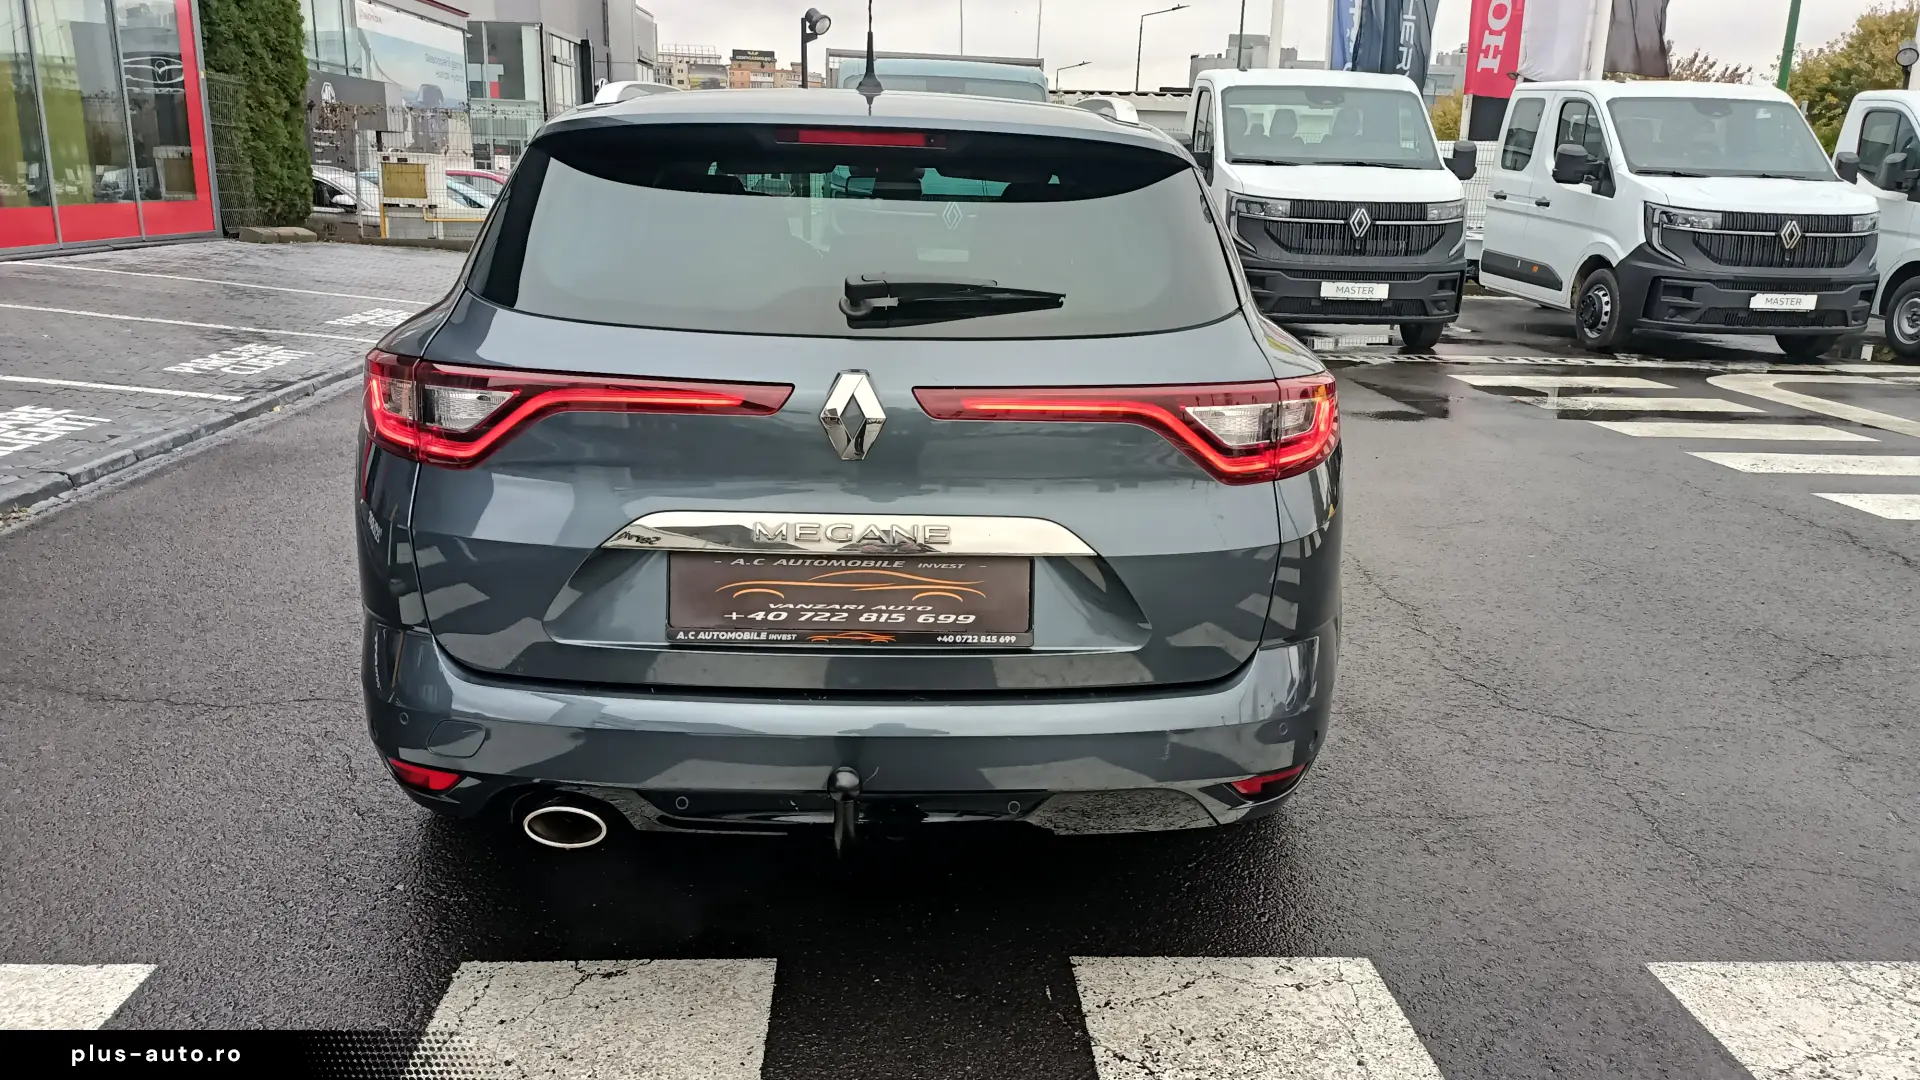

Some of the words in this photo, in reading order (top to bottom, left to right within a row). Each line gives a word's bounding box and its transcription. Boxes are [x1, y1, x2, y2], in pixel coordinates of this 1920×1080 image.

[1336, 286, 1375, 295] MASTER
[1765, 297, 1803, 306] MASTER
[754, 522, 951, 543] MEGANE
[730, 558, 766, 566] A.C
[772, 558, 906, 568] AUTOMOBILE
[768, 603, 865, 611] VANZARI
[723, 611, 789, 621] +40
[797, 612, 849, 622] 722
[858, 613, 906, 623] 815
[916, 614, 977, 624] 699
[676, 631, 696, 640] A.C
[697, 632, 768, 641] AUTOMOBILE
[768, 633, 798, 641] INVEST
[936, 635, 954, 643] +40
[955, 635, 979, 643] 0722
[980, 635, 998, 643] 815
[999, 636, 1017, 644] 699
